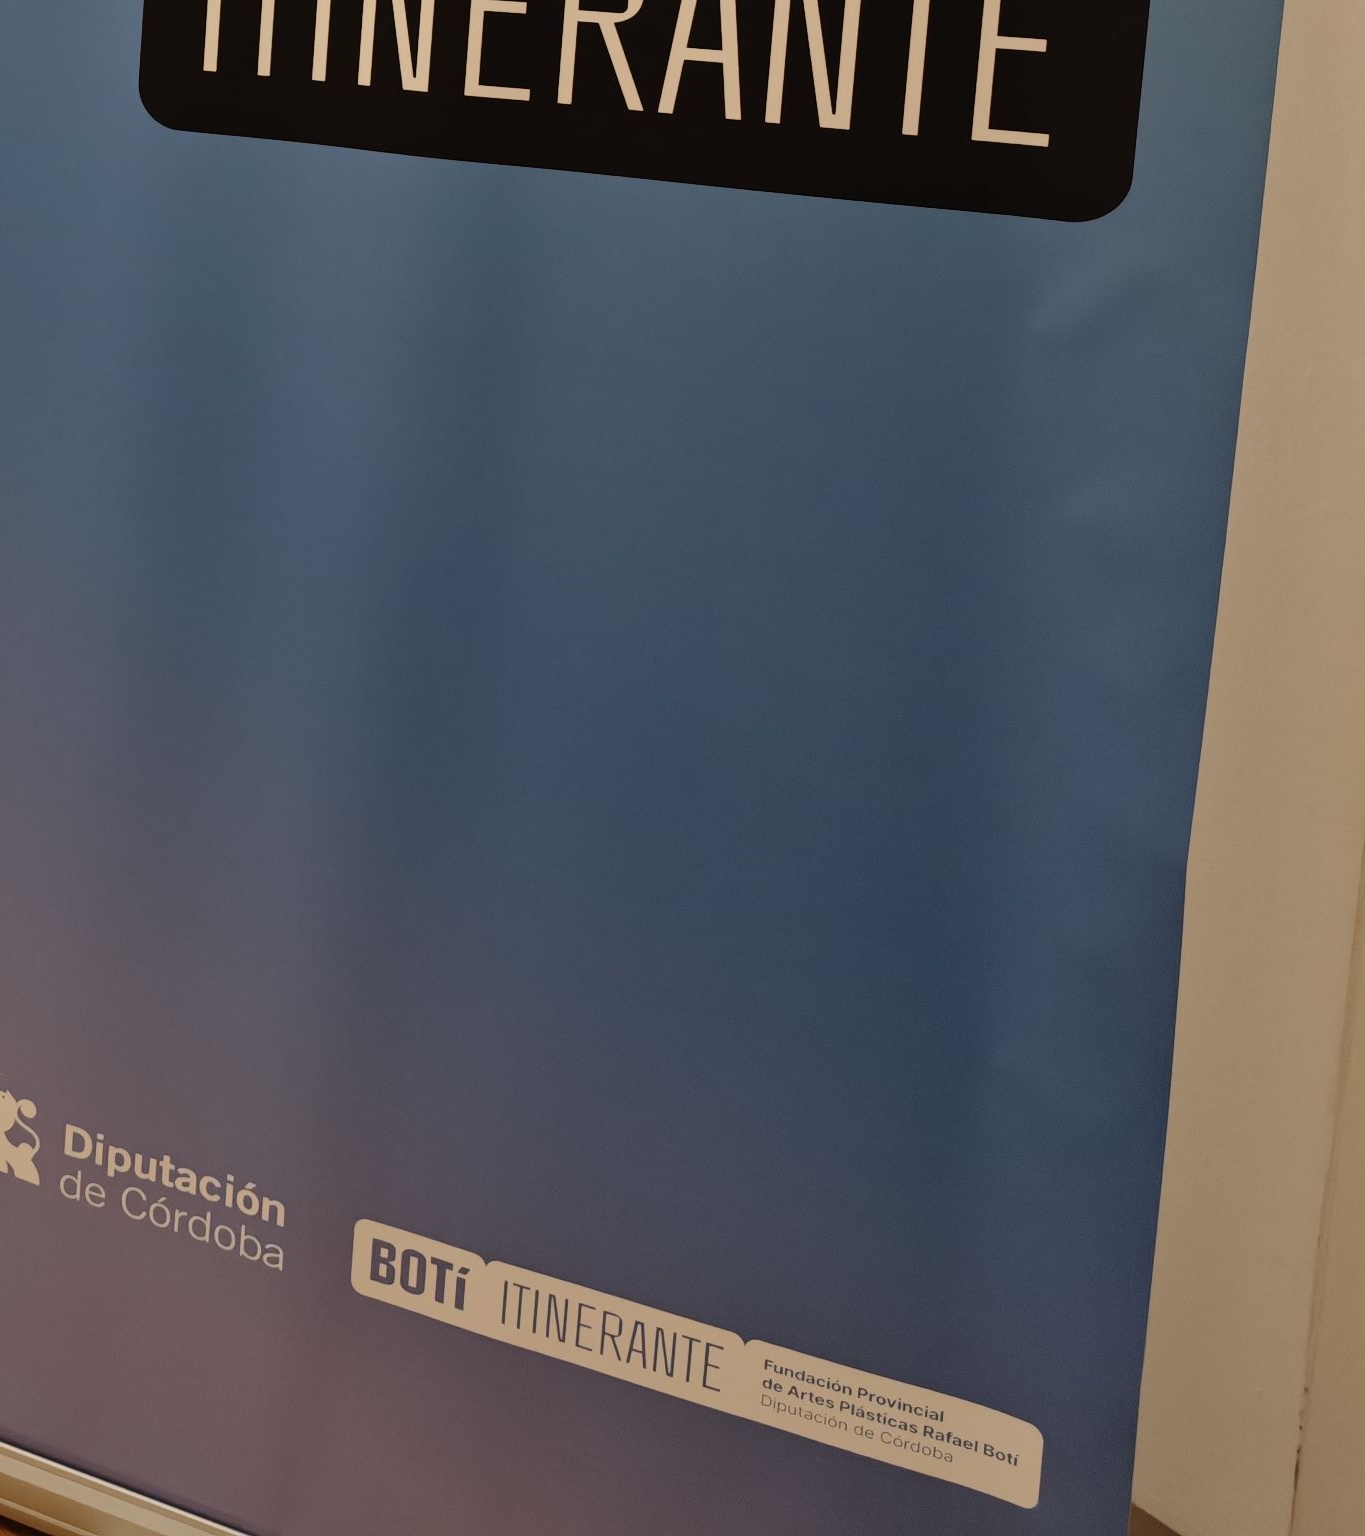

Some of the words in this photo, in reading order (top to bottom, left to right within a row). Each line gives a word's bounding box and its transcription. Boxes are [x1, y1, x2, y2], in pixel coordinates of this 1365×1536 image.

[59, 1170, 106, 1208] de
[121, 1186, 285, 1272] Córdoba
[63, 1123, 286, 1228] Diputación
[501, 1279, 726, 1393] ITINERANTE
[760, 1393, 848, 1432] Diputación
[853, 1423, 875, 1440] de
[879, 1431, 955, 1464] Córdoba
[762, 1377, 783, 1393] de
[787, 1385, 835, 1410] Artes
[839, 1400, 918, 1435] Plásticas
[922, 1424, 980, 1453] Rafael
[982, 1443, 1020, 1467] Botí
[764, 1358, 853, 1397] Fundación
[857, 1386, 945, 1423] Provincial
